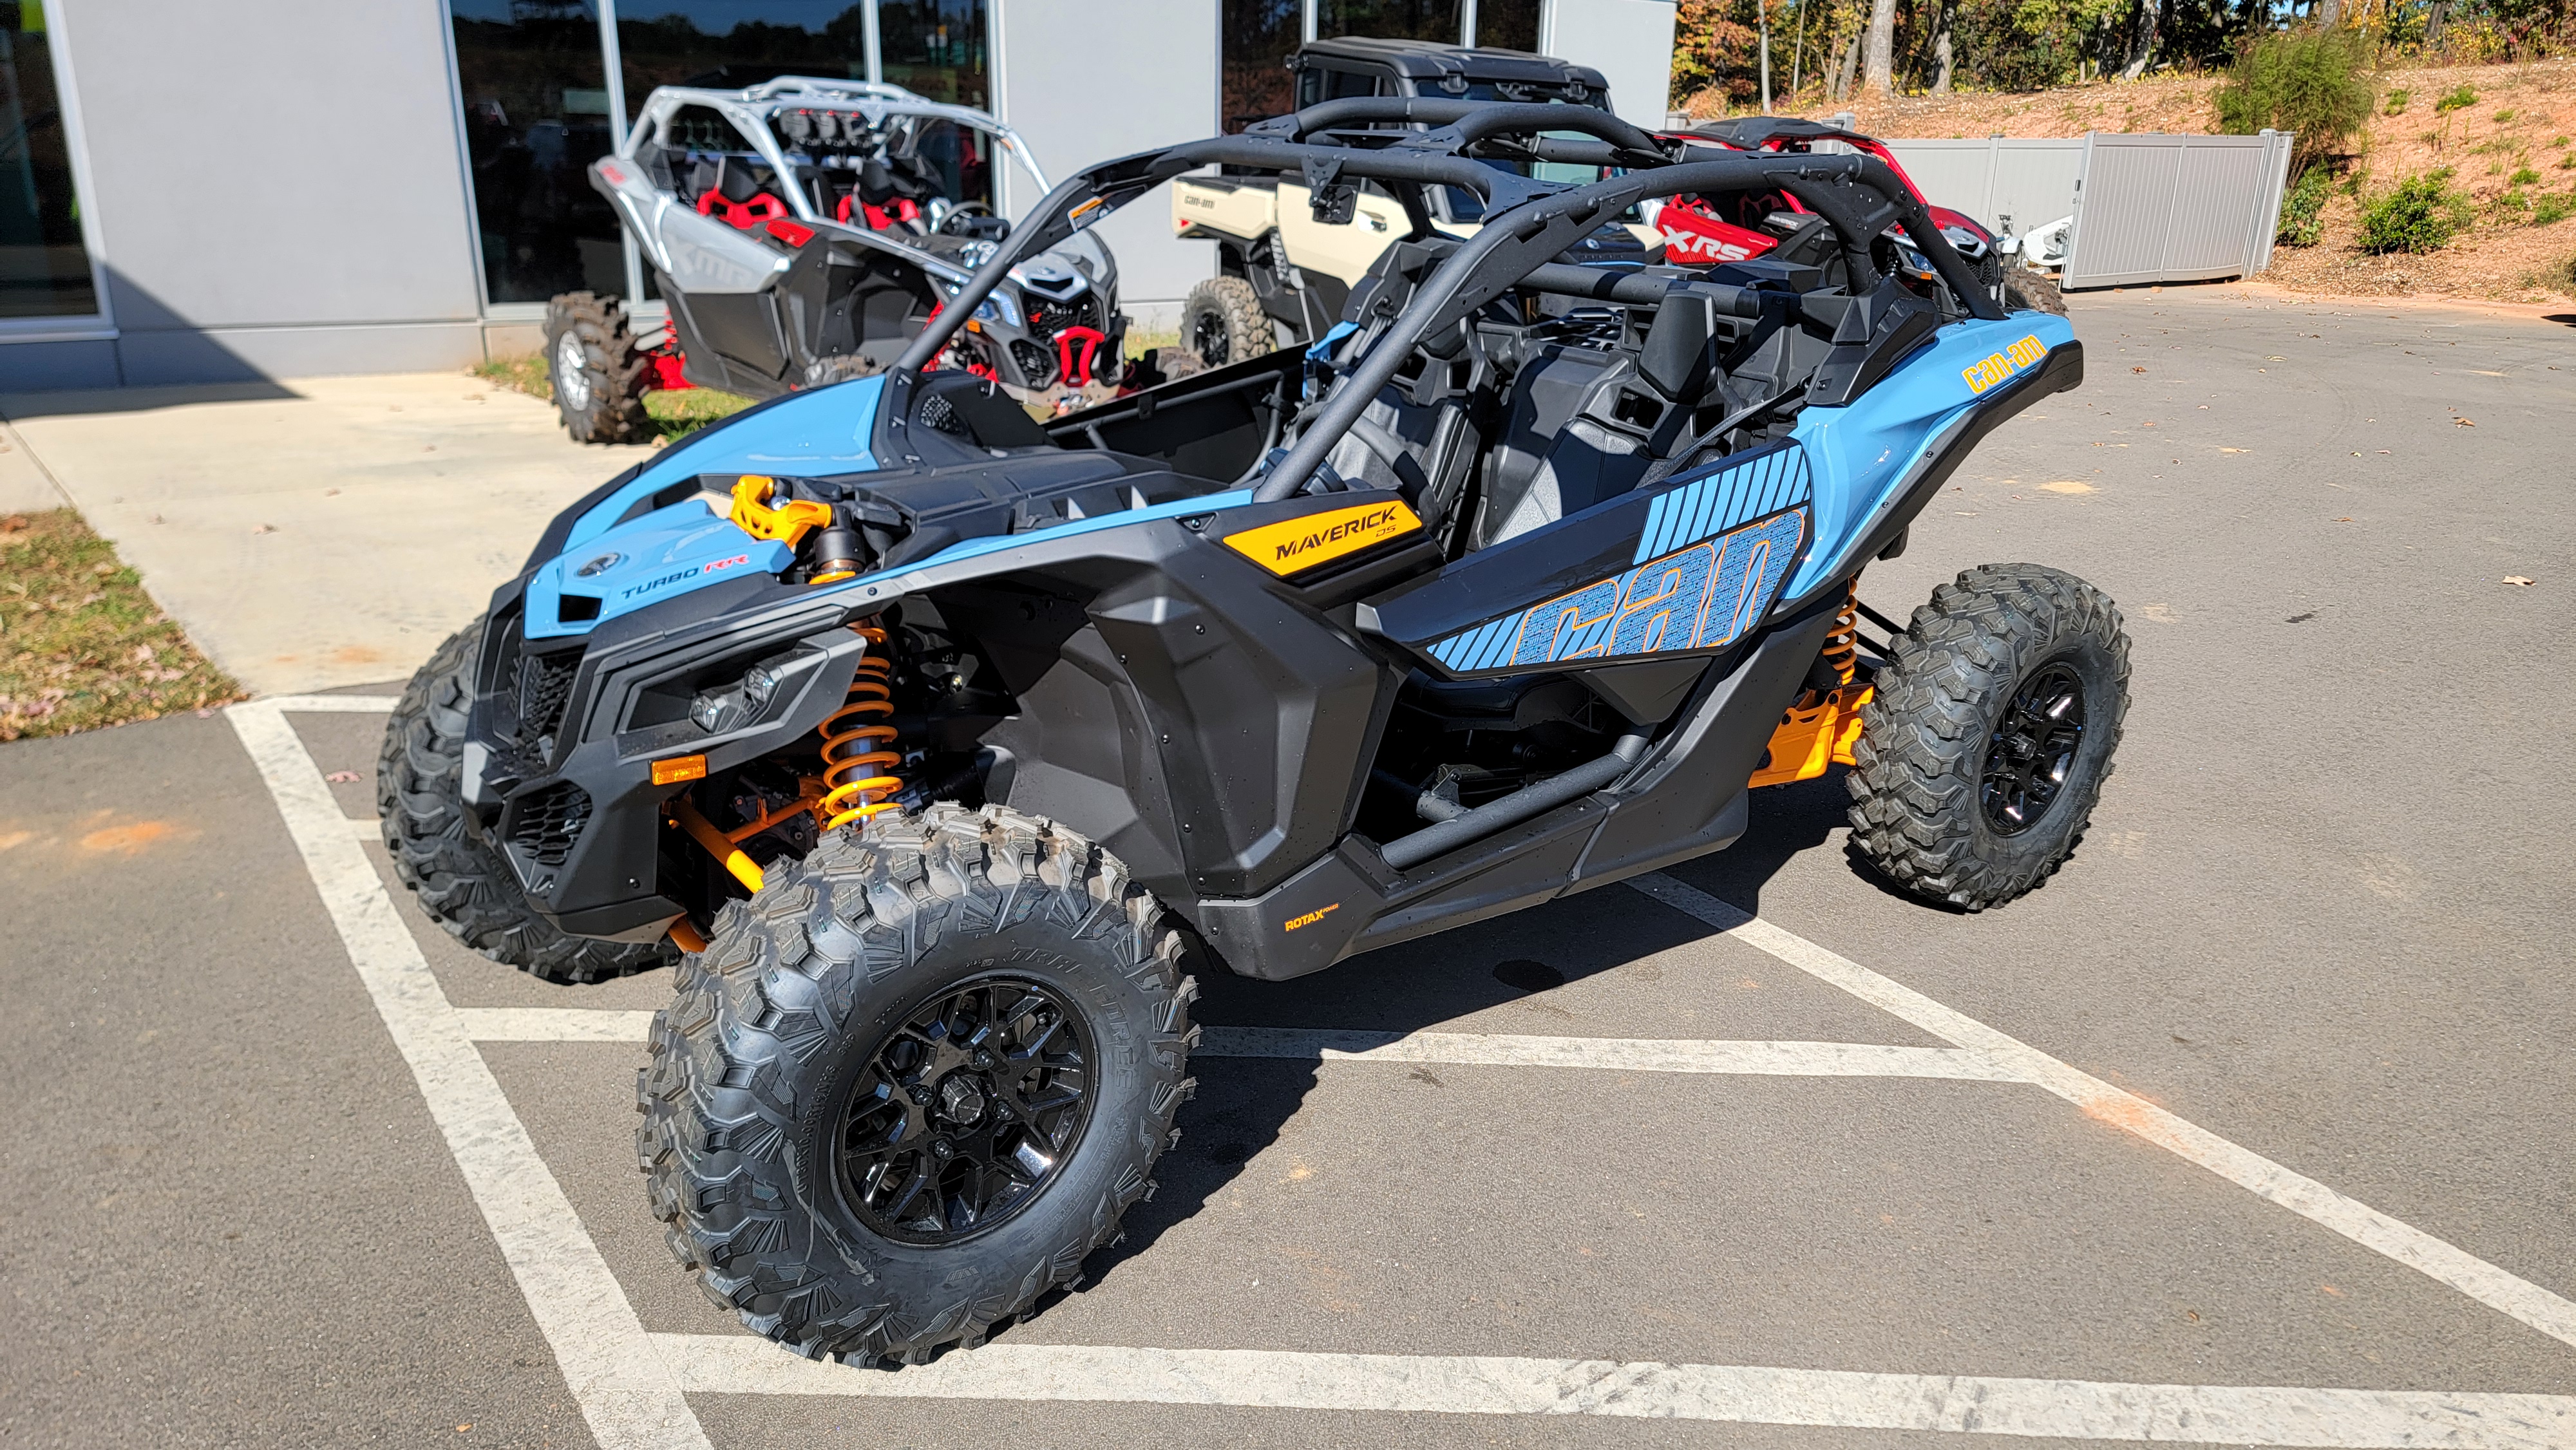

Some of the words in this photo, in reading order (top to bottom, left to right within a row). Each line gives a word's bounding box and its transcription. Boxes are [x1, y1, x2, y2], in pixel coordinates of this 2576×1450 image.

[1663, 225, 1750, 261] XRS
[1961, 334, 2048, 395] can-am
[1276, 505, 1397, 560] MAVERICK
[1376, 524, 1397, 538] DS
[621, 567, 699, 599] TURBO
[703, 554, 750, 574] RR
[1285, 909, 1324, 932] ROTAX
[1088, 983, 1134, 1090] FORCE
